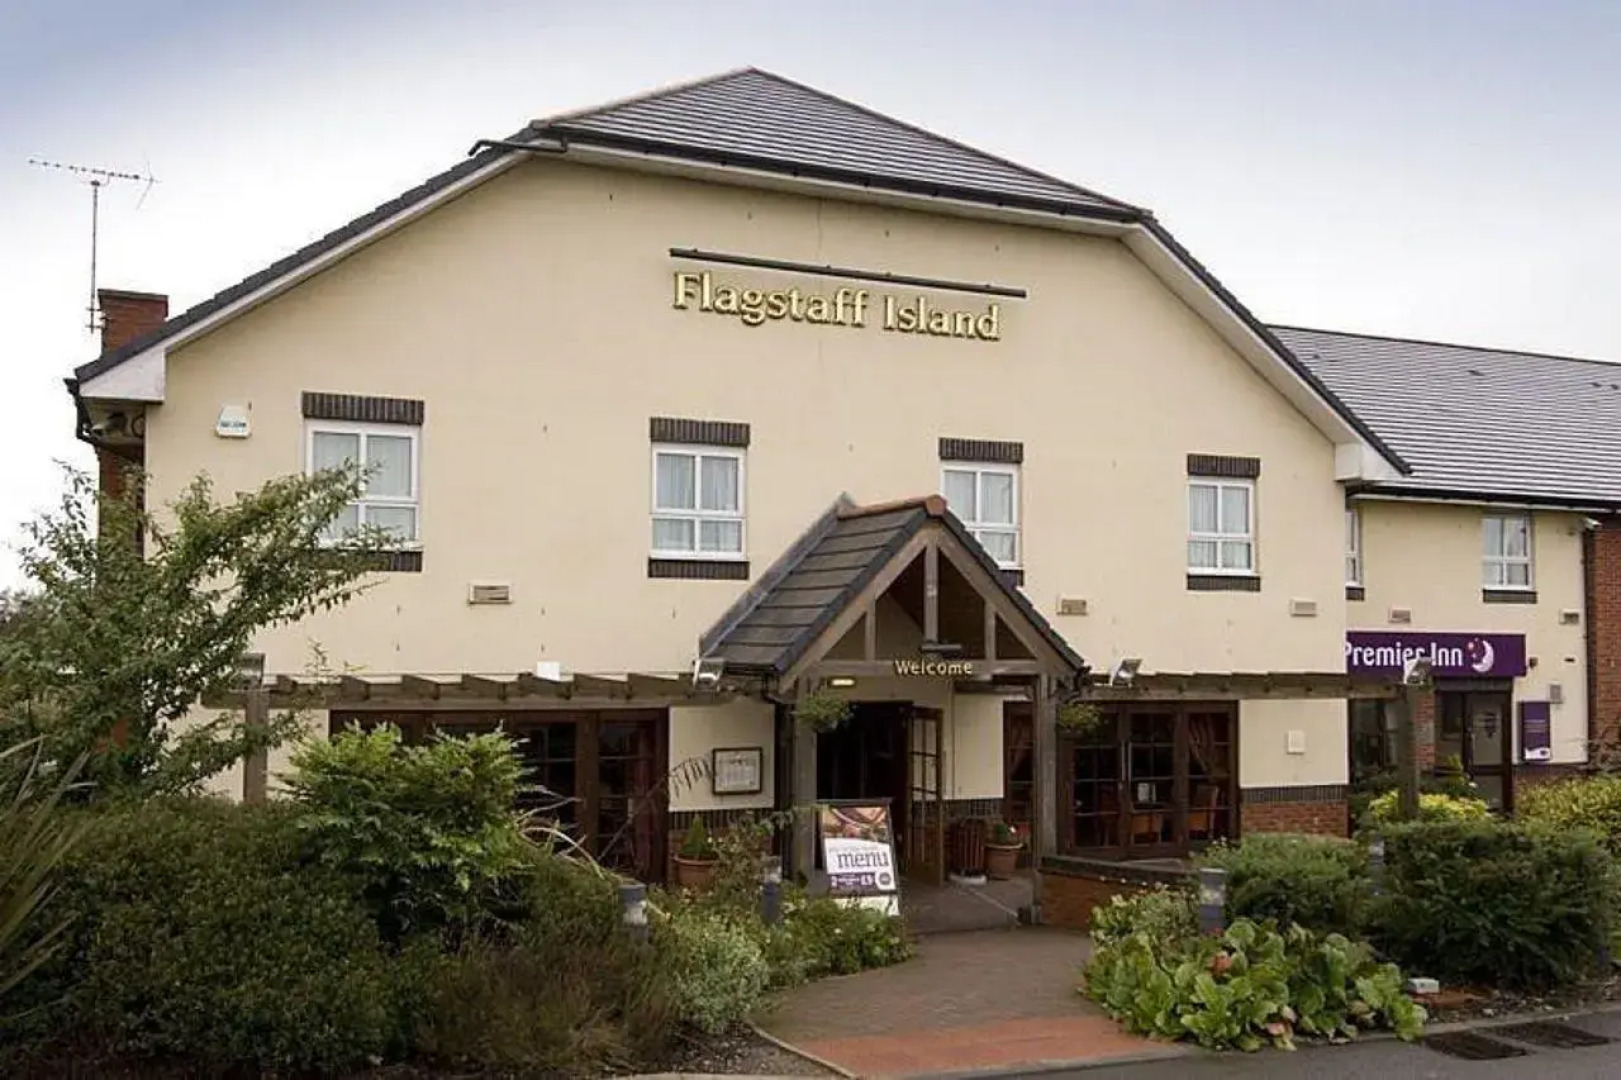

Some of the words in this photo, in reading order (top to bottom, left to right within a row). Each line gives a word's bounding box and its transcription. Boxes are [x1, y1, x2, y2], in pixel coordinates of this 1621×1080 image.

[672, 270, 868, 327] Flagstaff
[883, 295, 1001, 341] Island
[1430, 642, 1463, 667] Inn
[894, 658, 973, 676] Welcome
[837, 851, 889, 868] menu
